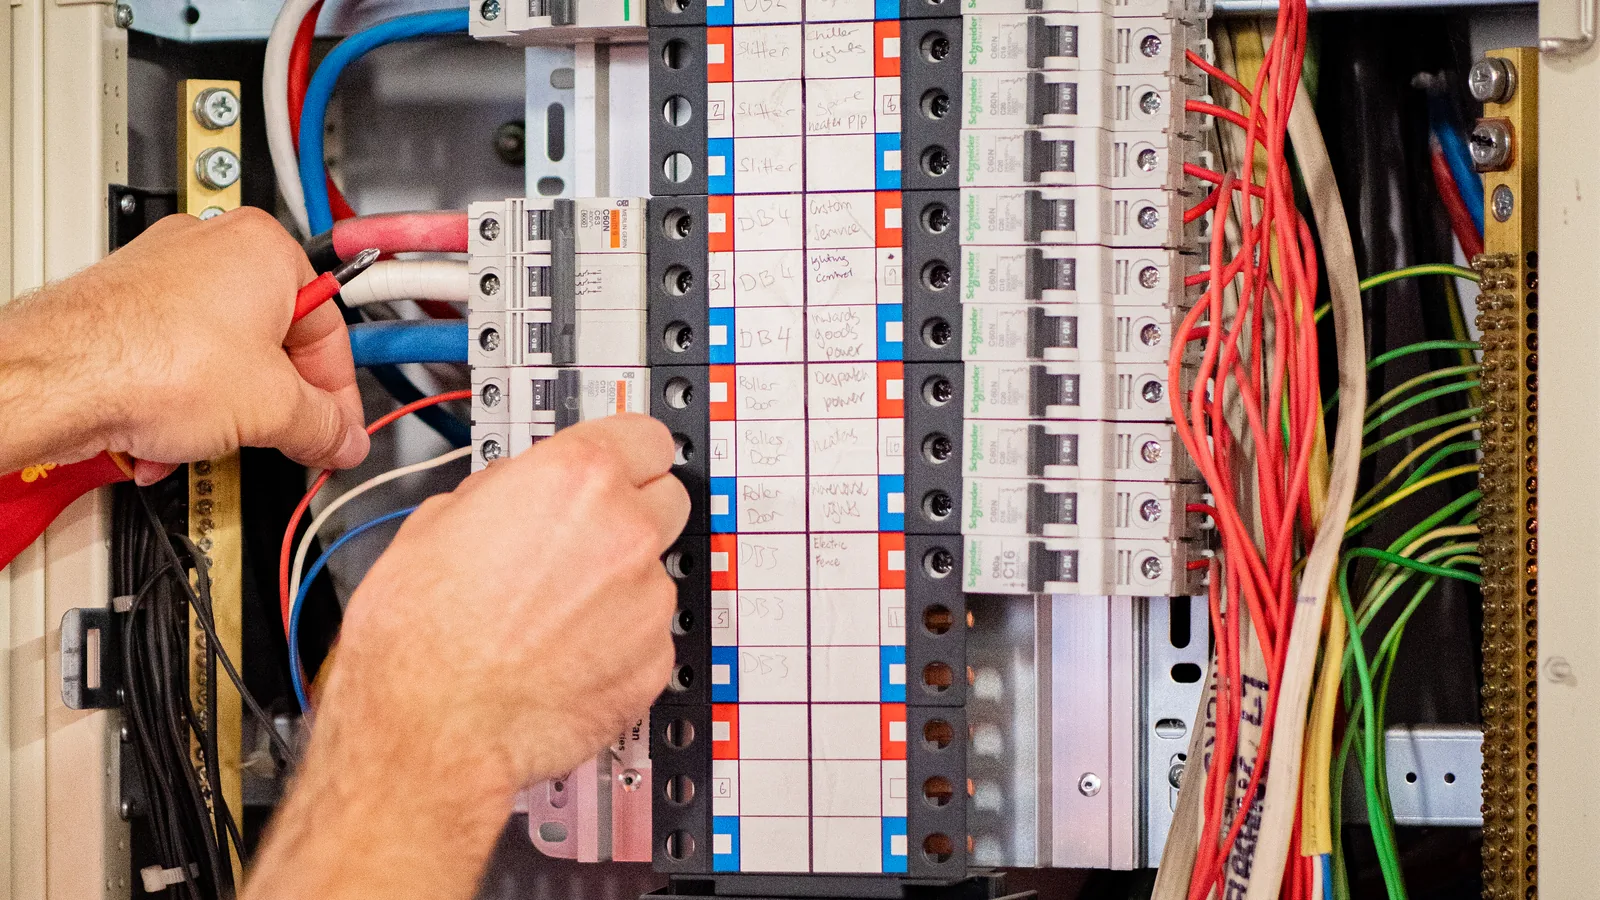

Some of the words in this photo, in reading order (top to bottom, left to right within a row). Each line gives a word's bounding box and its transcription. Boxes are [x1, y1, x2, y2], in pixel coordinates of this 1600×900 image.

[968, 16, 983, 64] Schneider
[968, 77, 982, 124] Schneider
[738, 155, 798, 173] Slitter
[966, 135, 980, 182] Schneider
[966, 194, 980, 241] Schneider
[712, 274, 720, 290] 3
[966, 252, 980, 299] Schneider
[969, 307, 983, 355] Schneider
[971, 365, 984, 413] Schneider
[969, 424, 983, 471] Schneider
[969, 482, 983, 529] Schneider
[968, 540, 981, 587] Schneider
[1004, 551, 1015, 579] C16
